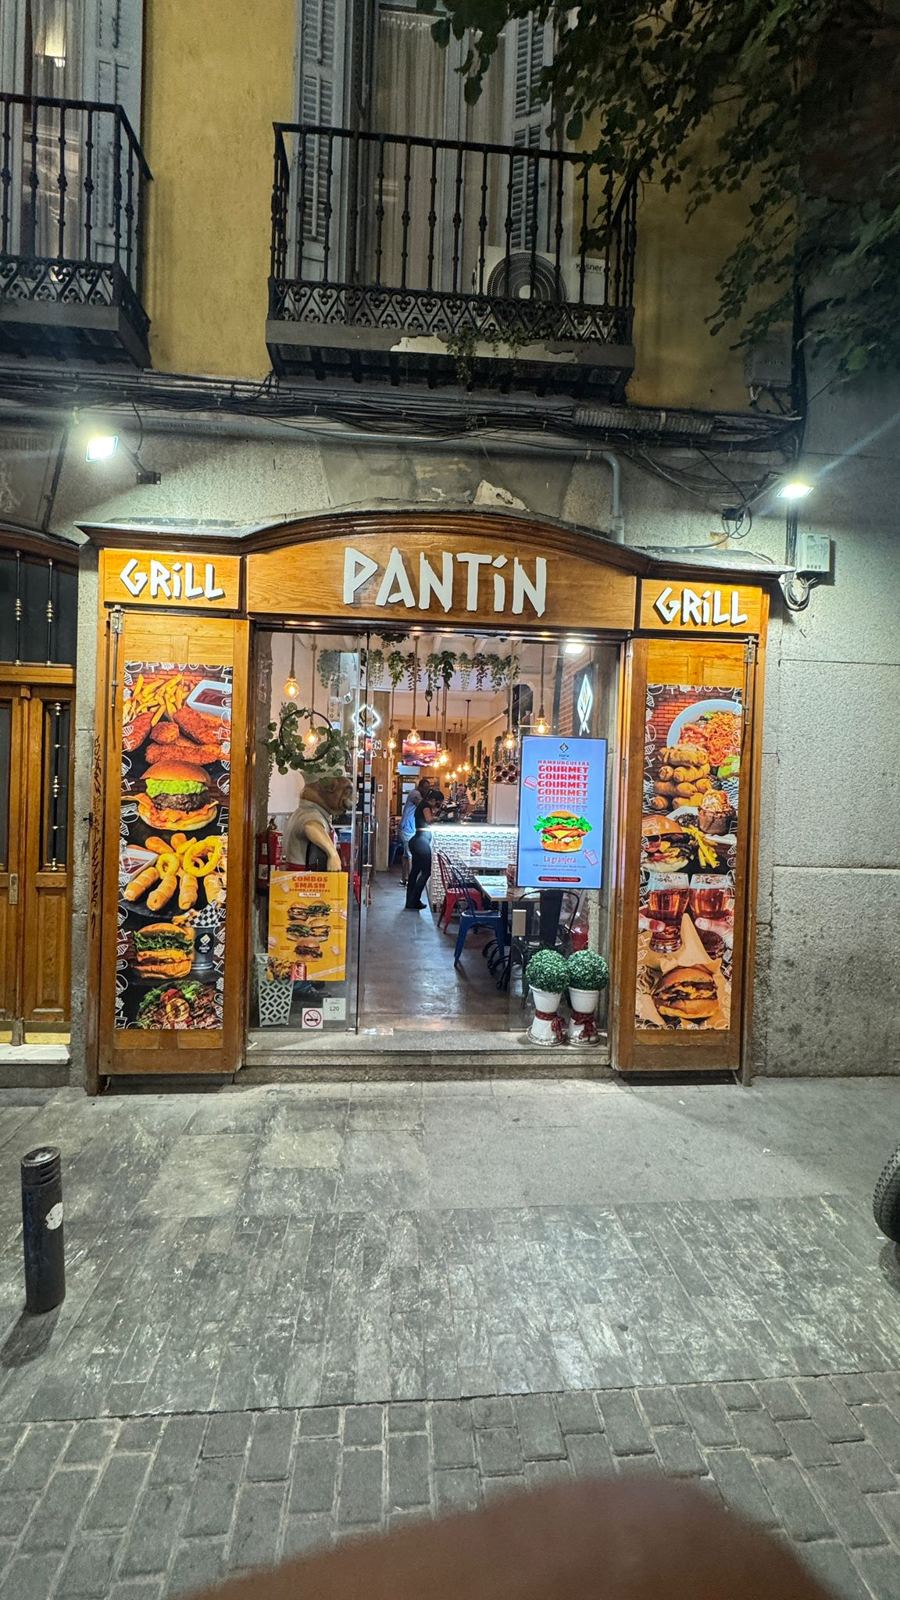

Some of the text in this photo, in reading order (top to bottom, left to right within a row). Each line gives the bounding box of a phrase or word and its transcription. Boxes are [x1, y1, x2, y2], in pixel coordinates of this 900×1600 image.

[538, 773, 589, 781] GOURMET
[538, 788, 588, 796] GOURMET
[538, 796, 588, 804] GOURMET
